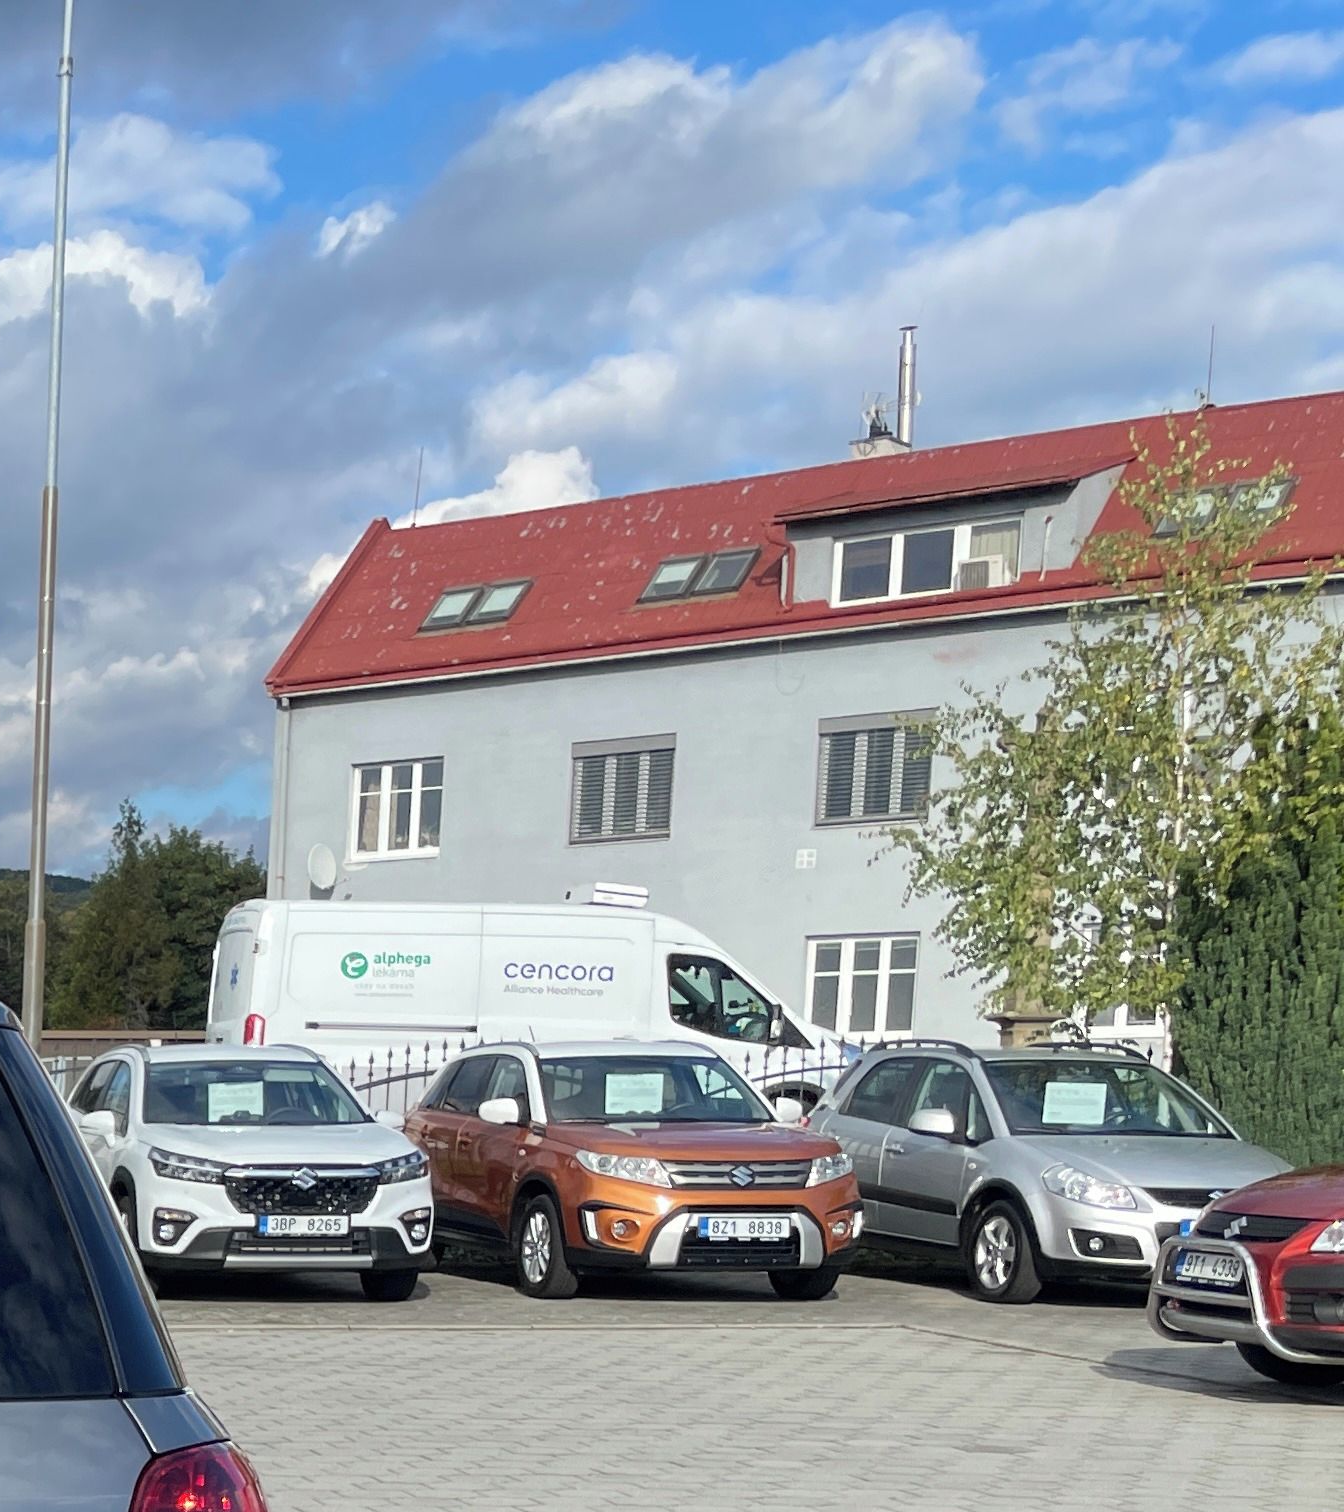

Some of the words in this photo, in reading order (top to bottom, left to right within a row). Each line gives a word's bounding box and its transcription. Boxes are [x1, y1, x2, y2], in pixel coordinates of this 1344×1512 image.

[373, 951, 431, 967] alphega
[504, 962, 614, 982] cencora
[503, 984, 544, 994] Alliance
[547, 985, 604, 996] Healthcare
[271, 1217, 297, 1231] 3BP
[307, 1218, 341, 1232] 8265
[712, 1220, 737, 1234] 8Z1
[748, 1221, 782, 1235] 8838
